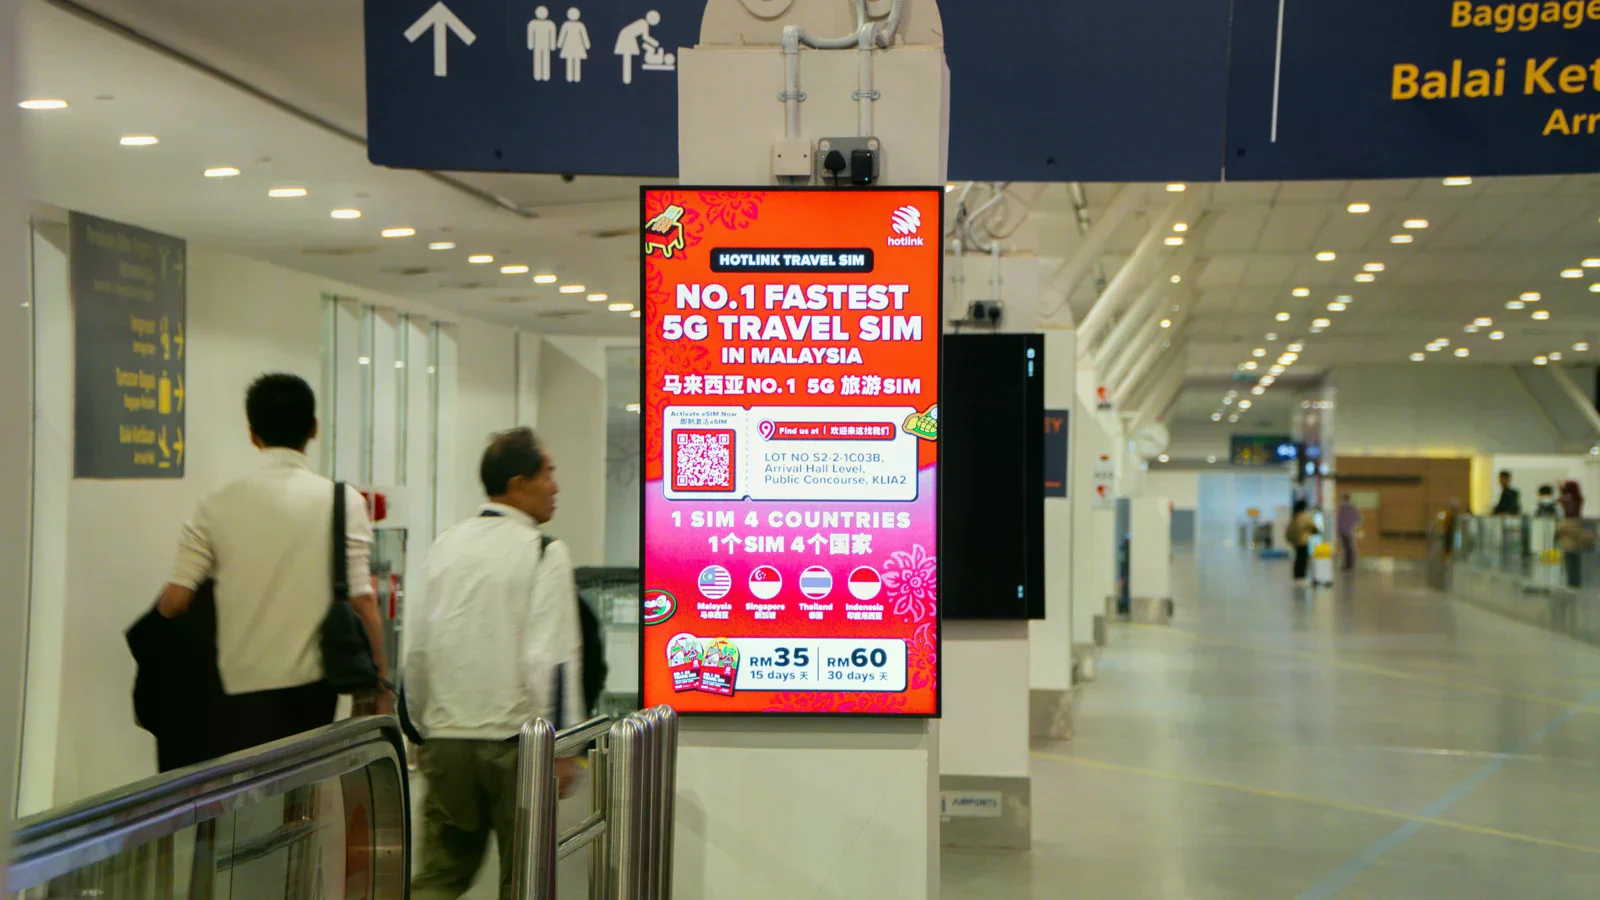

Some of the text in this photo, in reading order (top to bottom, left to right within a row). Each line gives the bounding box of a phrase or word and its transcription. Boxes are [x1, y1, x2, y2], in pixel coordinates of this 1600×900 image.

[1451, 0, 1600, 33] Baggage
[1391, 57, 1506, 100] Balai
[887, 236, 924, 246] hotlink
[719, 254, 865, 266] HOTLINK TRAVEL SIM
[676, 284, 909, 310] NO.1 FASTEST
[662, 315, 923, 341] 5G TRAVEL SIM
[721, 347, 863, 364] IN MALAYSIA
[807, 378, 835, 395] 5G
[778, 426, 797, 435] Find
[811, 427, 819, 435] at
[764, 453, 787, 462] LOT
[791, 453, 809, 462] NO
[764, 464, 866, 474] Arrival Hall Level,
[764, 475, 907, 485] Public Concourse, KLIA2
[671, 511, 911, 528] 1 SIM 4 COUNTRIES
[790, 533, 872, 555] 4个国家
[697, 602, 733, 611] Malaysia
[745, 602, 785, 611] Singapore
[799, 602, 833, 610] Thailand
[750, 647, 809, 667] RM35
[827, 648, 887, 667] RM60
[750, 670, 808, 681] 15 days 天
[828, 671, 888, 682] 30 days 天
